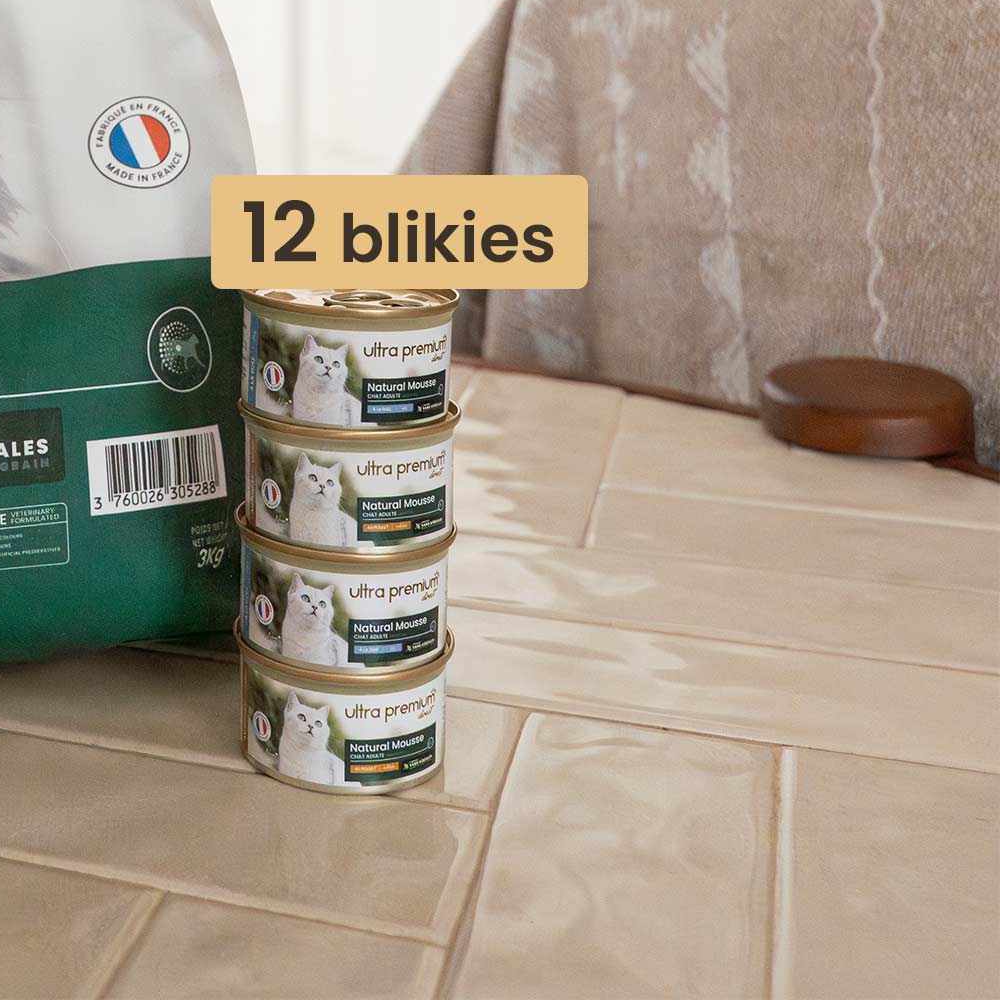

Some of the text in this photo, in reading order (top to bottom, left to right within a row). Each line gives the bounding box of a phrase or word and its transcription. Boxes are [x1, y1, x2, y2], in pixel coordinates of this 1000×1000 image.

[130, 103, 143, 111] EN
[147, 104, 181, 133] FRANCE
[105, 163, 134, 180] MADE
[152, 152, 182, 180] FRANCE
[363, 338, 448, 362] ultra premium
[367, 378, 437, 393] Natural Mousse
[0, 457, 51, 473] GRAIN
[357, 454, 445, 480] ultra premium
[94, 481, 217, 510] 3 760026 305288
[362, 494, 436, 511] Natural Mousse
[349, 576, 439, 602] ultra premium
[354, 615, 428, 633] Natural Mousse
[345, 694, 436, 723] ultra premium
[350, 734, 425, 752] Natural Mousse
